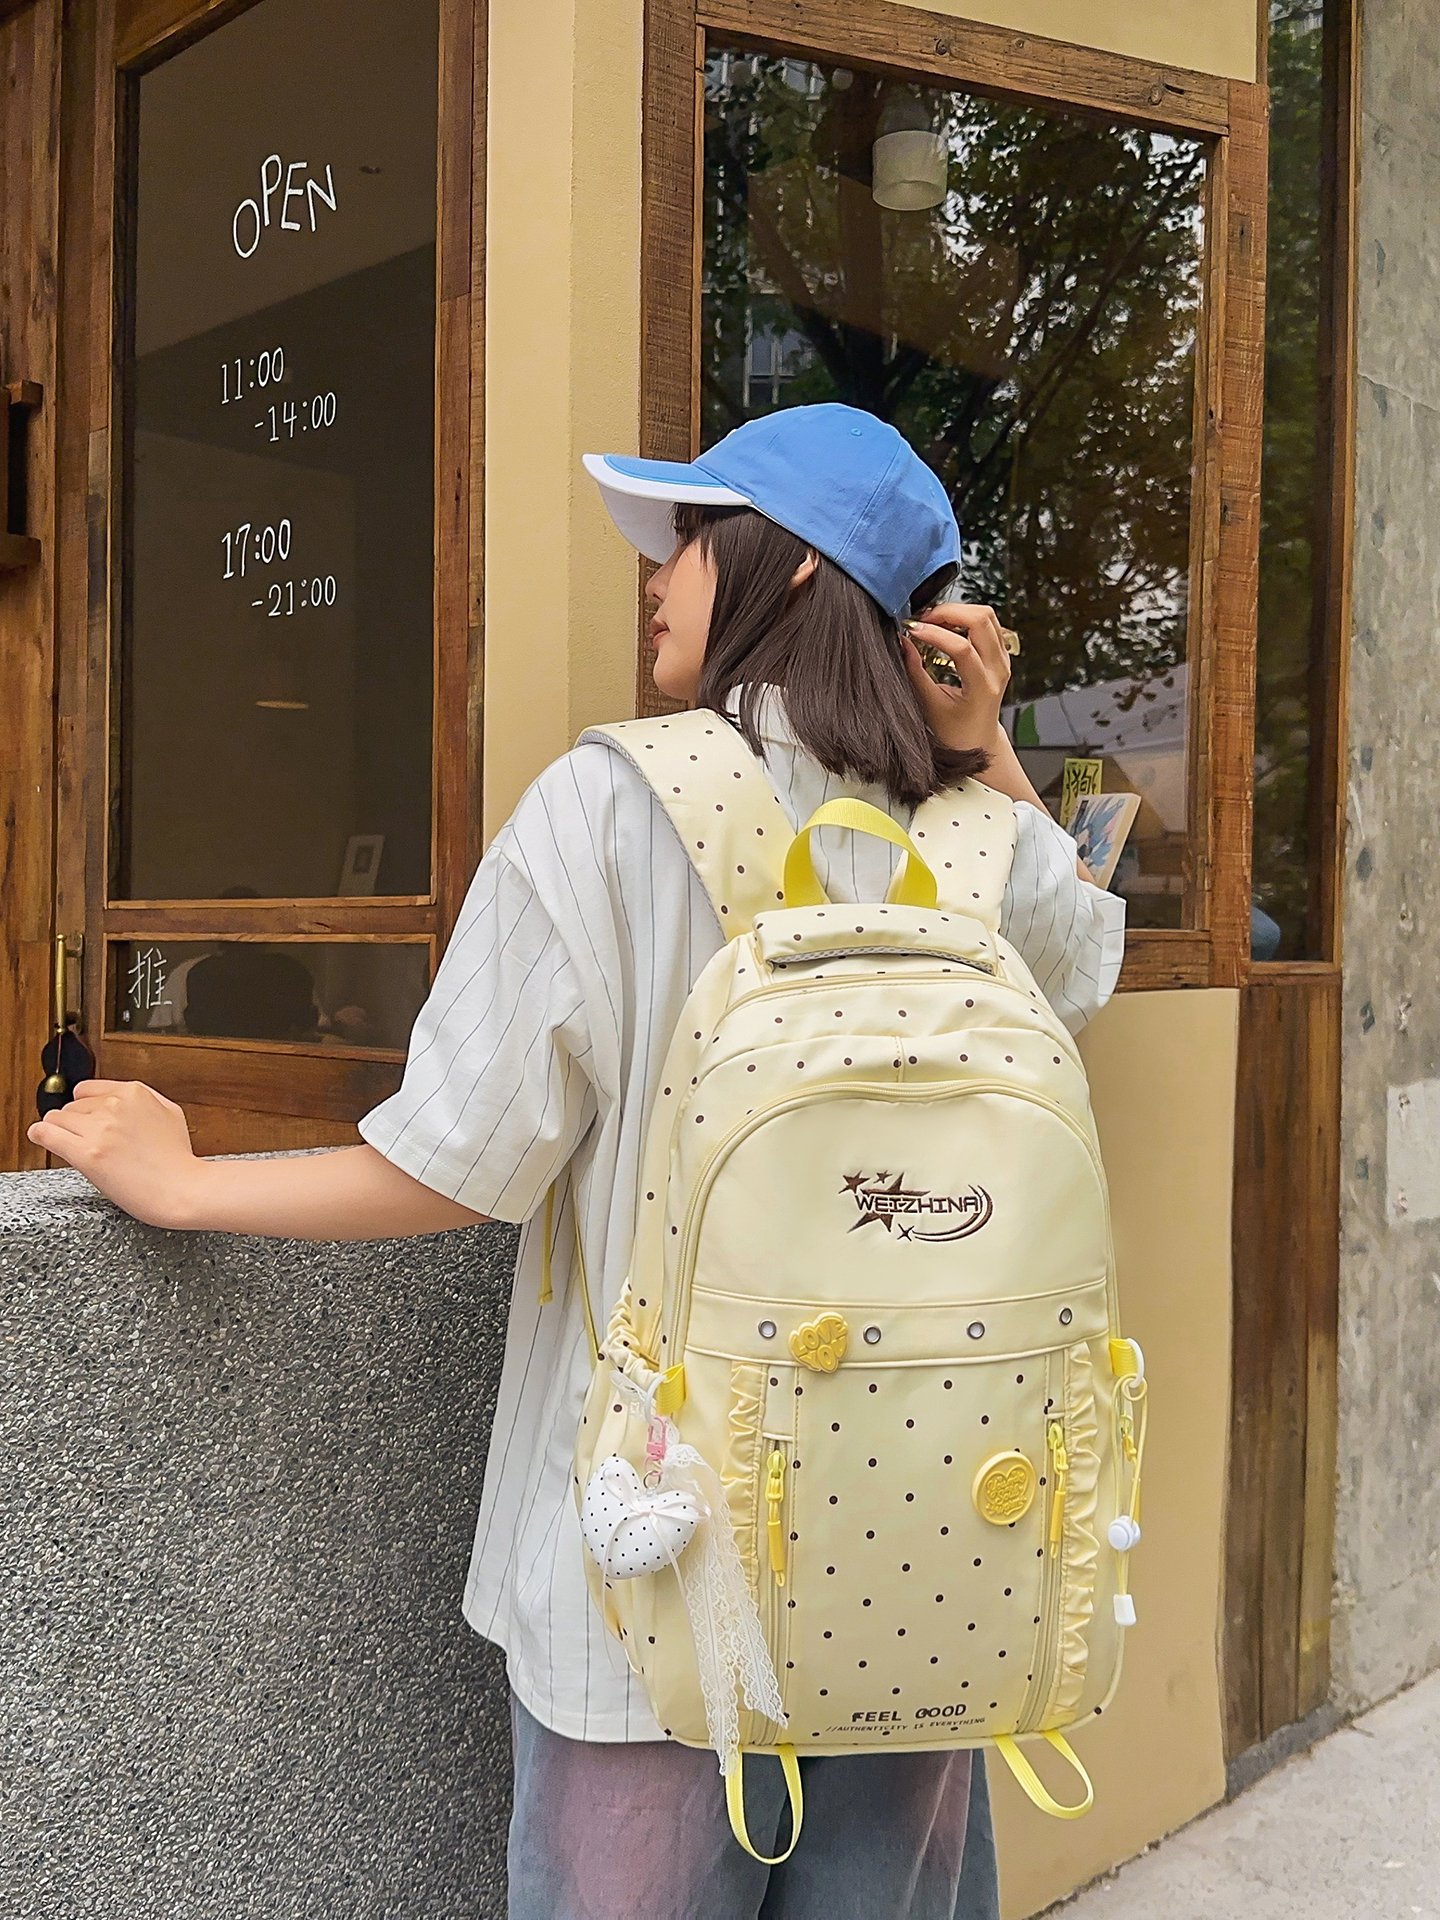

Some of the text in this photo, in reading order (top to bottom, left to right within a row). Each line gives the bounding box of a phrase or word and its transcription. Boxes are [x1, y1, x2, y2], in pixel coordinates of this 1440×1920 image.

[233, 154, 337, 259] OPEN
[221, 346, 285, 404] 11:00
[254, 391, 336, 442] -14:00
[221, 518, 292, 579] 17:00
[251, 575, 336, 617] -21:00
[128, 947, 173, 1010] 推
[854, 1195, 980, 1214] WEIZHINA
[852, 1703, 967, 1723] FEEL GOOD
